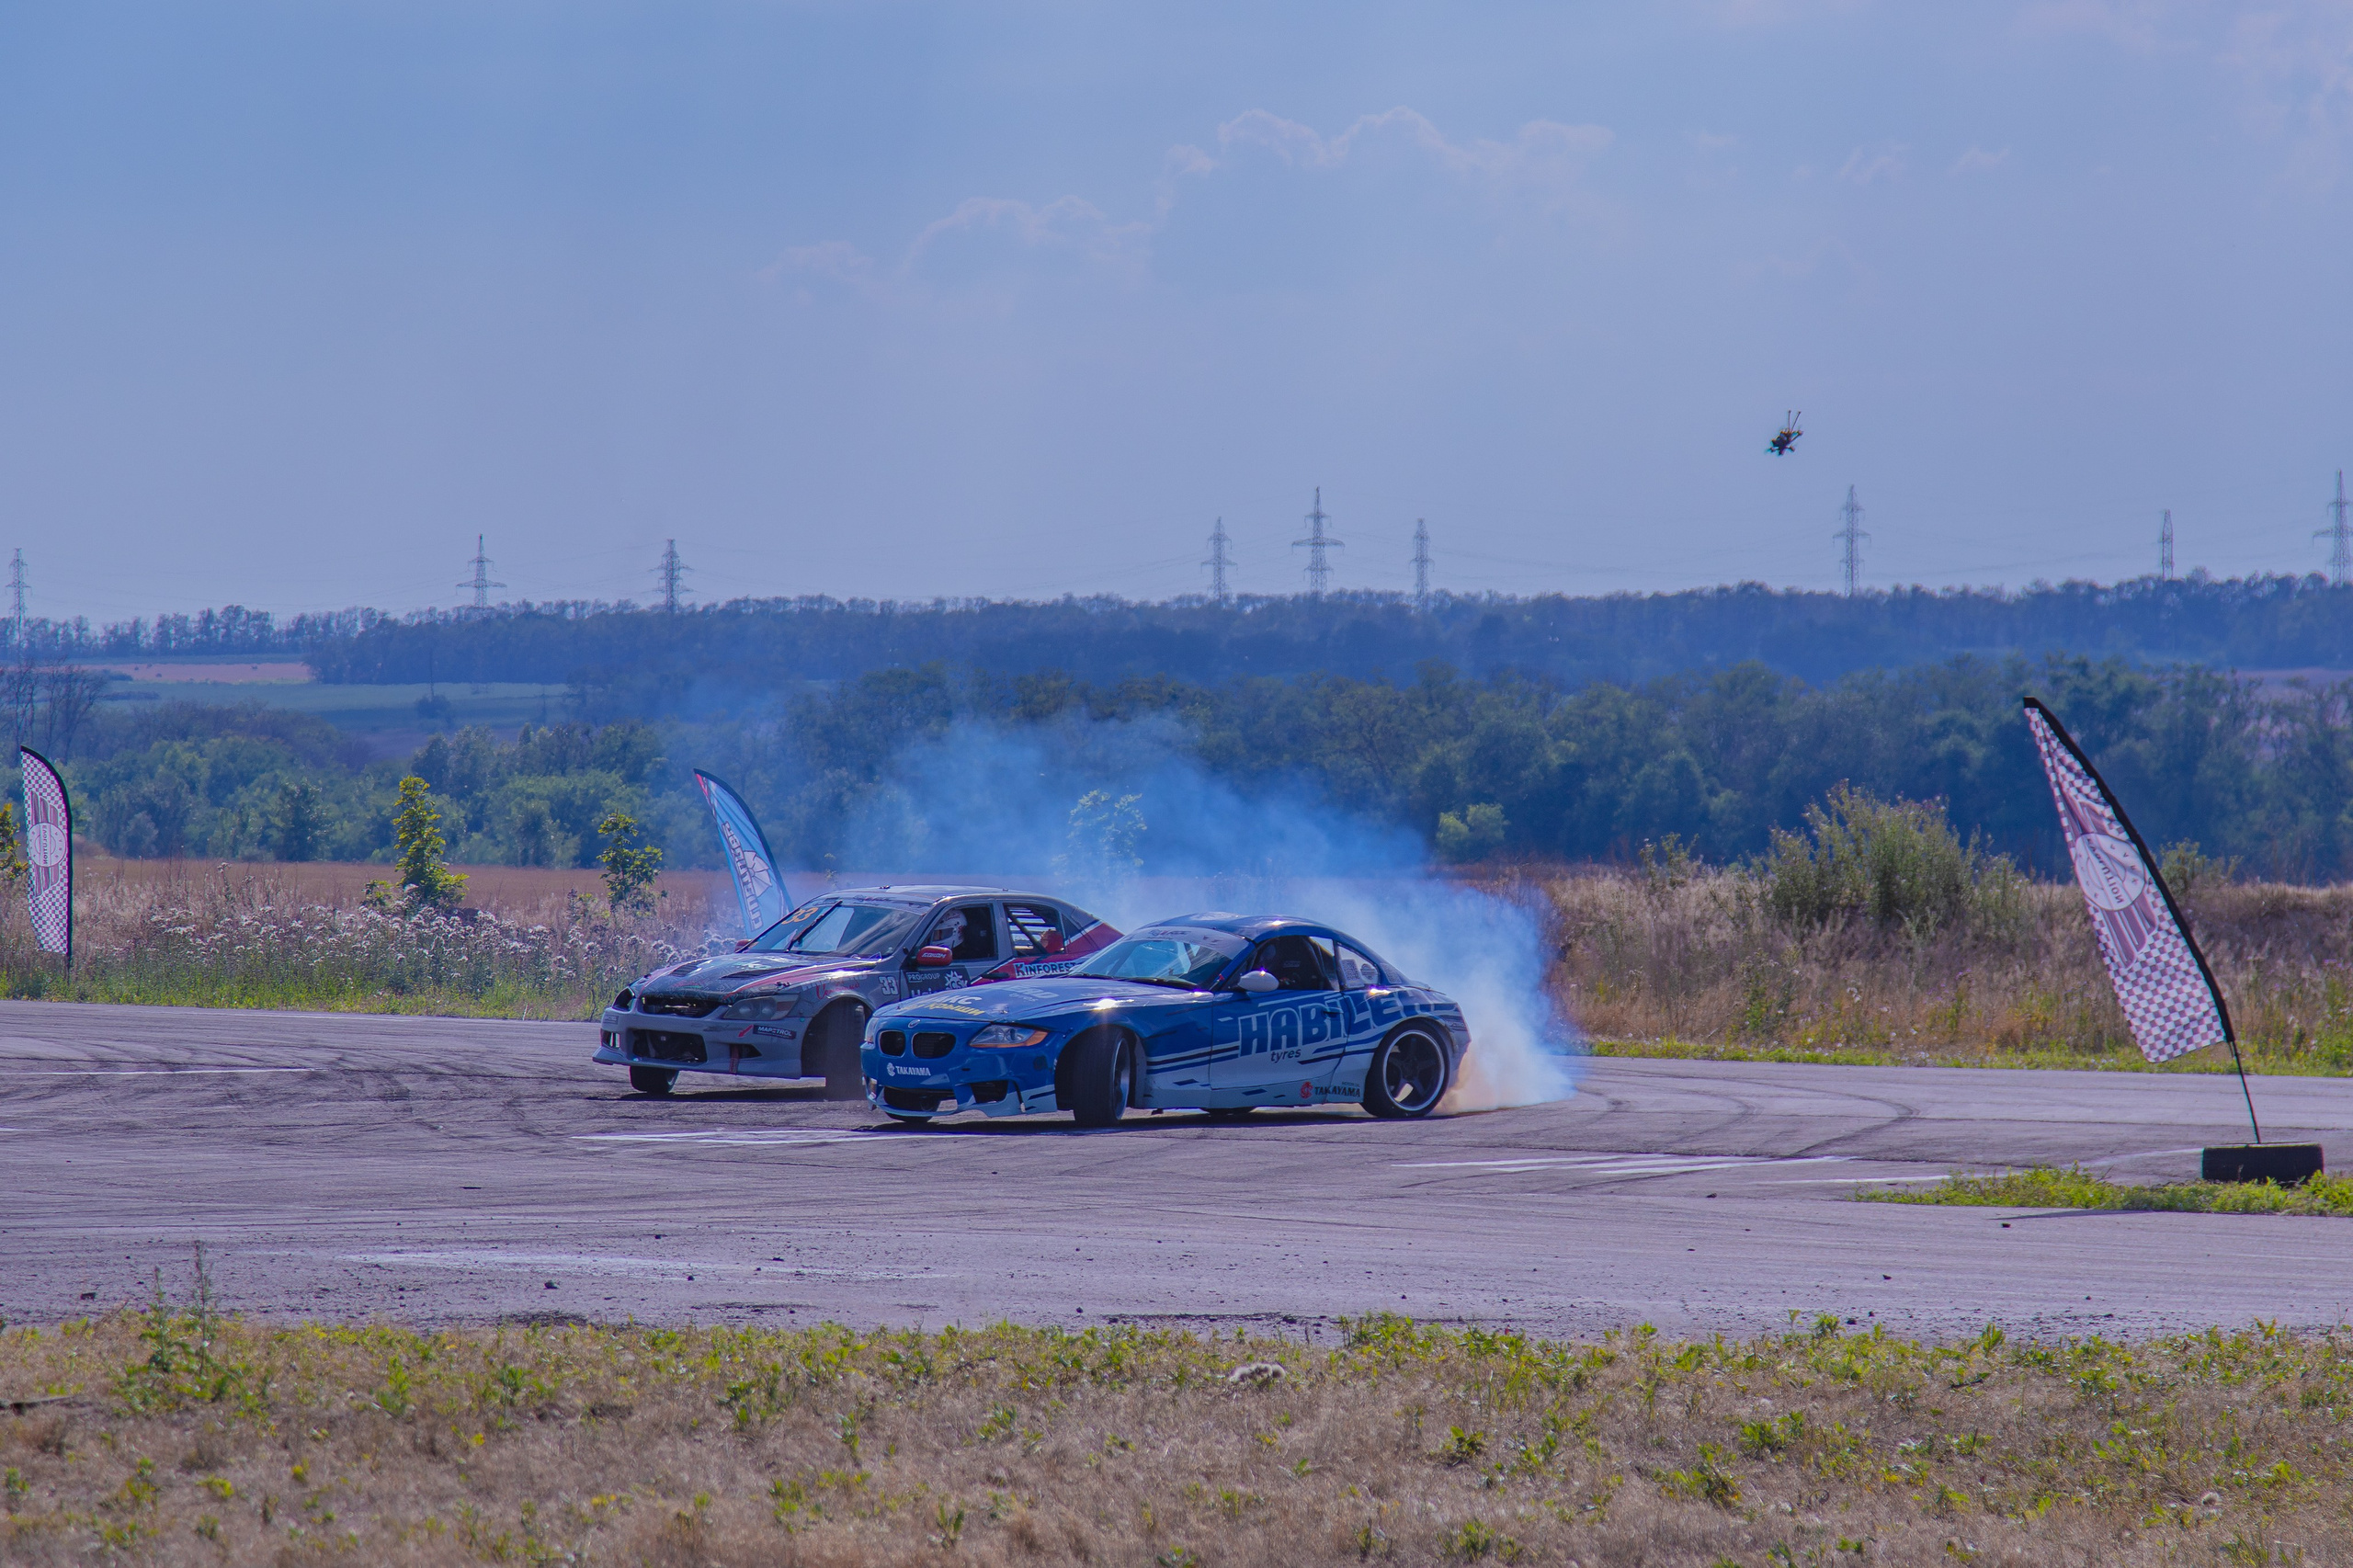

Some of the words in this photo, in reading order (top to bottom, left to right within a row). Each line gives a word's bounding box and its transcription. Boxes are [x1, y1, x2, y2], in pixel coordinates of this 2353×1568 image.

[781, 906, 819, 925] 33
[879, 976, 899, 995] 33
[1270, 1048, 1302, 1063] tyres
[895, 1065, 931, 1076] TAKAYAMA
[1314, 1085, 1360, 1097] TAKAYAMA
